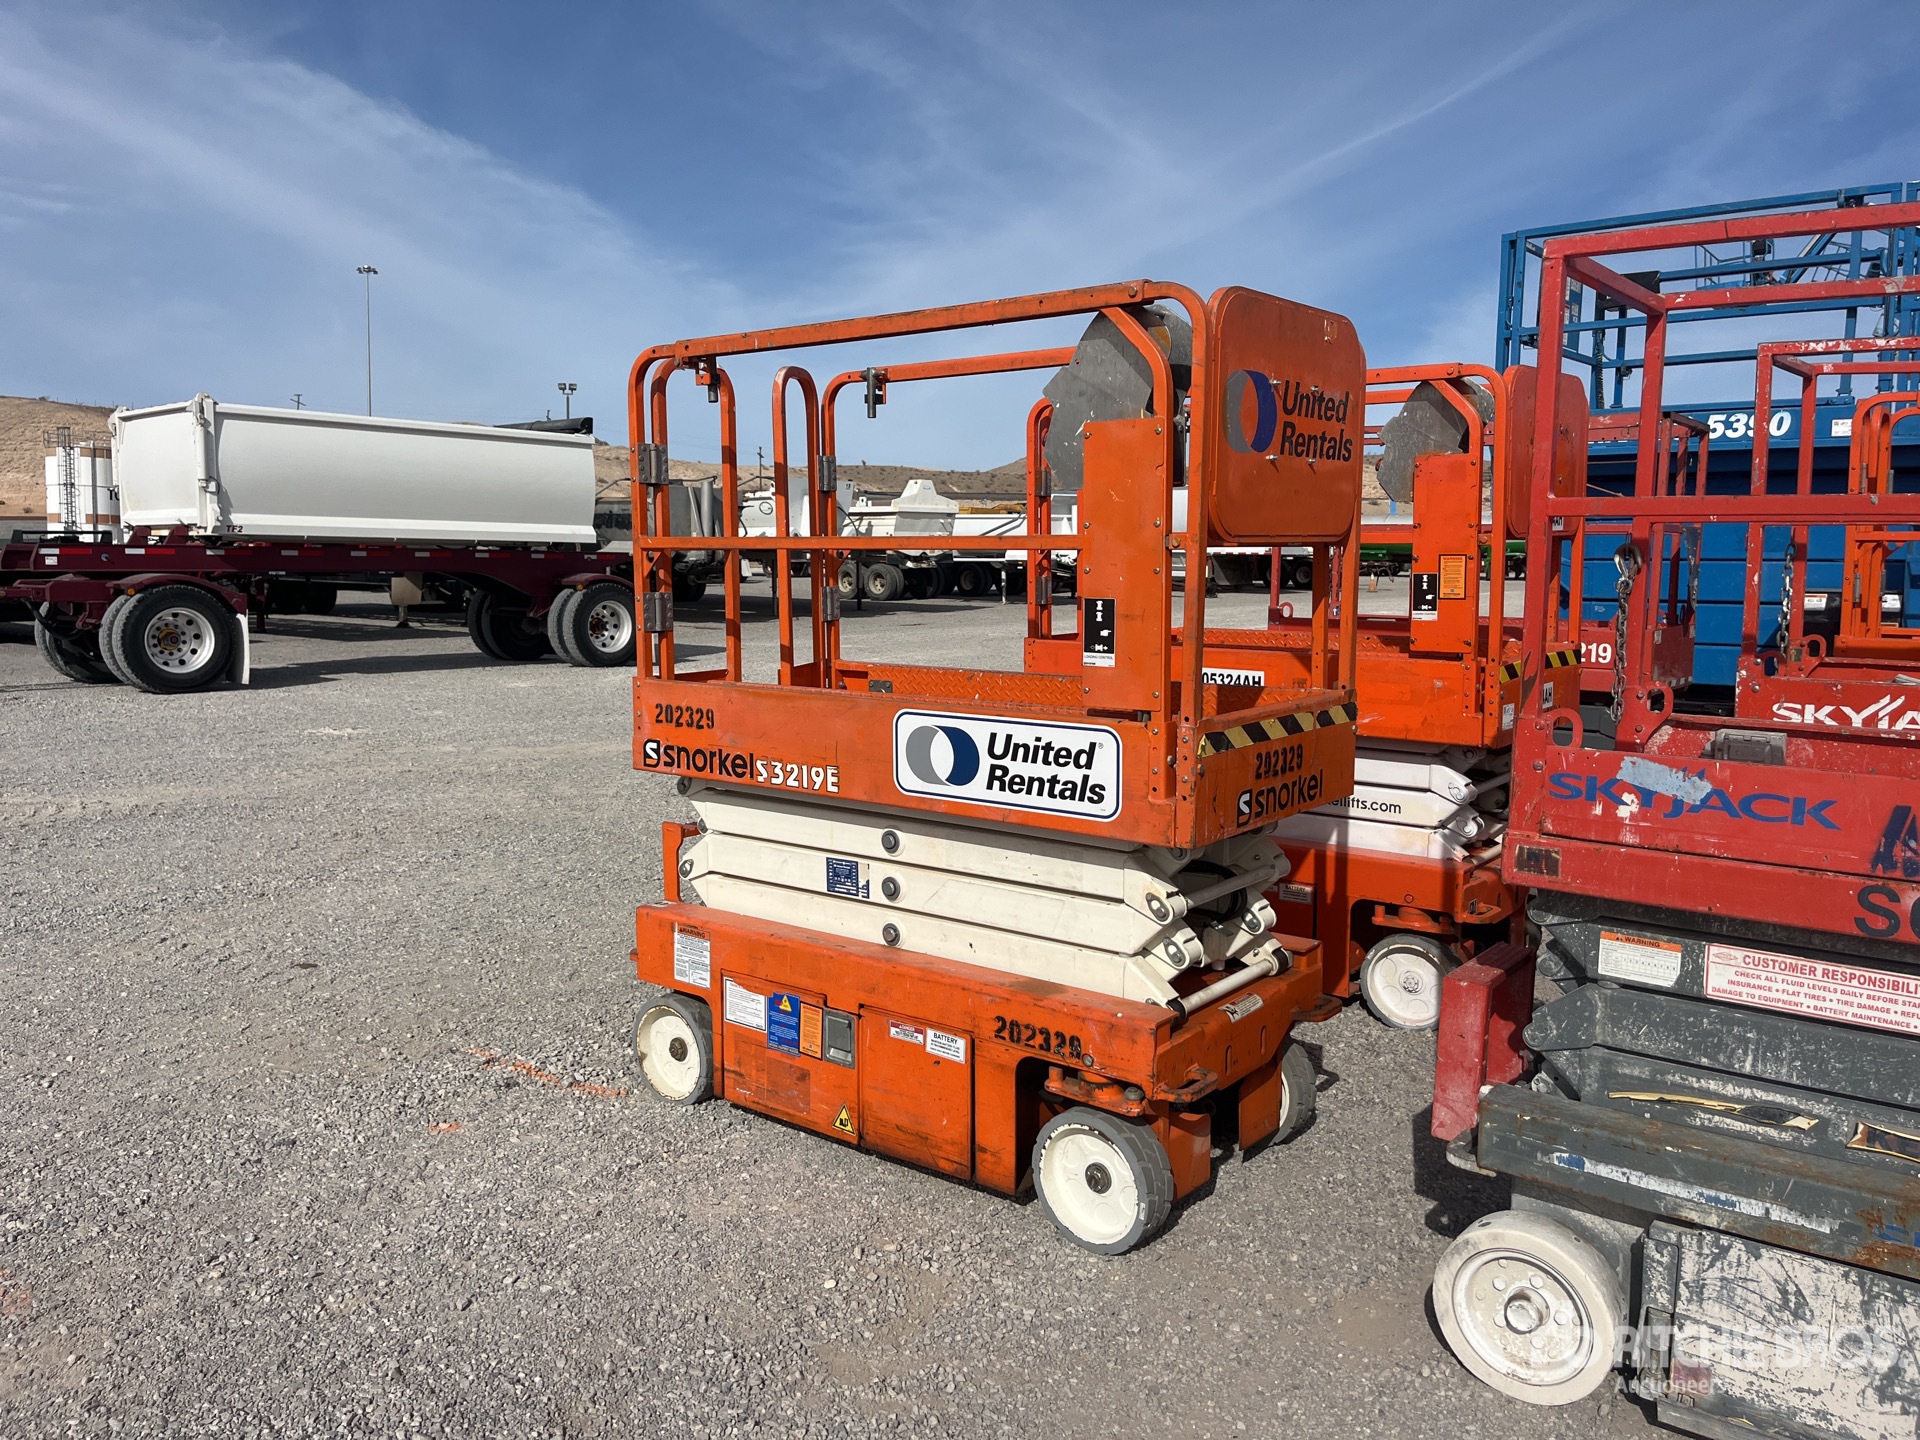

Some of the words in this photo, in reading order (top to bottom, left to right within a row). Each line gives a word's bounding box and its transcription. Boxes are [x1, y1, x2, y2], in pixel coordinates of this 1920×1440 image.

[1282, 380, 1349, 425] United
[1280, 421, 1352, 462] Rentals
[226, 525, 243, 533] TF2
[655, 703, 715, 730] 202329
[663, 744, 754, 780] snorkel
[987, 732, 1097, 770] United
[1255, 743, 1304, 780] 202329
[755, 759, 840, 794] S3219E
[986, 763, 1107, 804] Rentals
[1254, 768, 1324, 819] snorkel
[1854, 884, 1920, 939] S
[1625, 936, 1660, 948] WARNING
[1734, 970, 1762, 980] CHECK
[1764, 975, 1779, 983] ALL
[1781, 978, 1804, 988] FLUID
[1807, 982, 1838, 994] LEVELS
[1840, 988, 1864, 999] DAILY
[1866, 993, 1899, 1005] BEFORE
[1743, 954, 1817, 977] CUSTOMER
[1821, 967, 1920, 995] RESPONSIBILI
[1711, 986, 1743, 997] DAMAGE
[1746, 992, 1756, 1000] TO
[1758, 995, 1804, 1009] EQUIPMENT
[1813, 1004, 1849, 1017] BATTERY
[1851, 1012, 1911, 1029] MAINTENANCE
[1728, 979, 1773, 992] INSURANCE
[1781, 988, 1801, 998] FLAT
[1803, 992, 1827, 1002] TIRES
[1836, 998, 1855, 1007] TIRE
[1857, 1003, 1891, 1014] DAMAGE
[933, 1032, 958, 1045] BATTERY
[994, 1015, 1082, 1060] 202329
